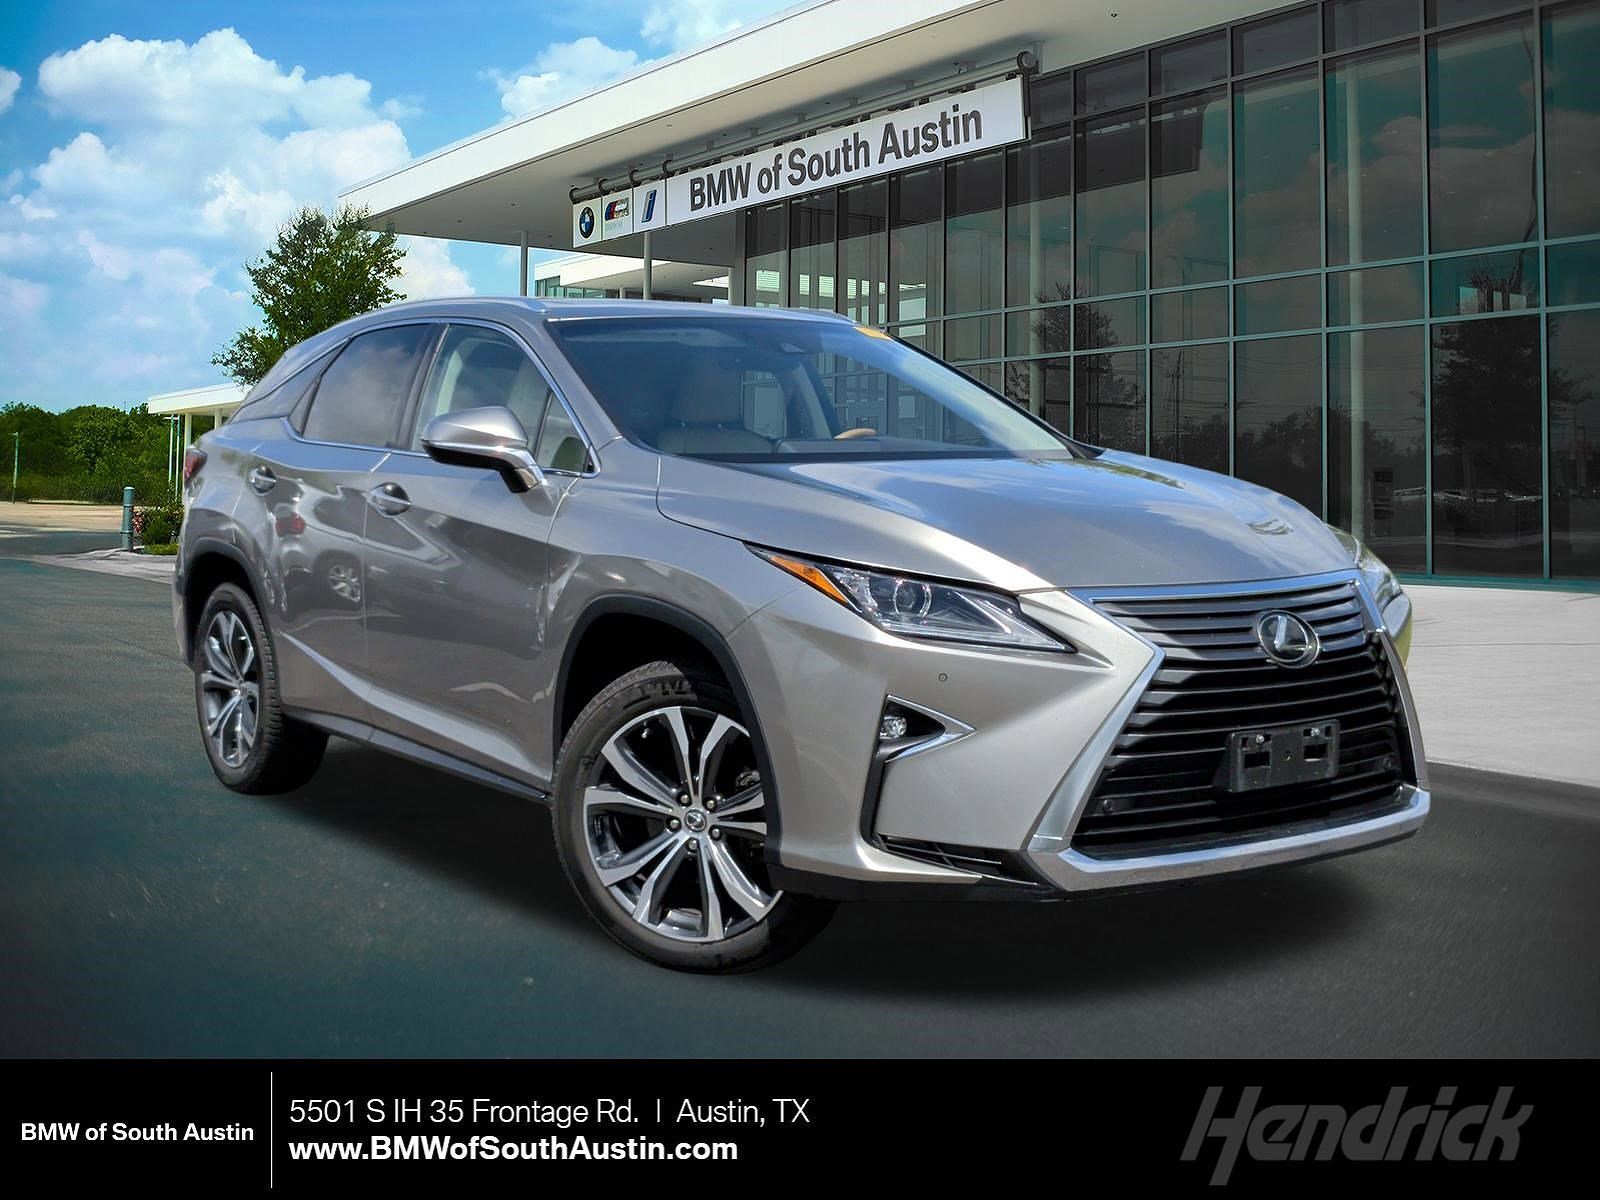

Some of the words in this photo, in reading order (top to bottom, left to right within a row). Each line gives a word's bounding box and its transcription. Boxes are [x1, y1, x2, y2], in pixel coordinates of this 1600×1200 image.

[690, 162, 751, 212] BMW
[757, 153, 783, 194] of
[787, 131, 870, 187] South
[878, 104, 982, 164] Austin
